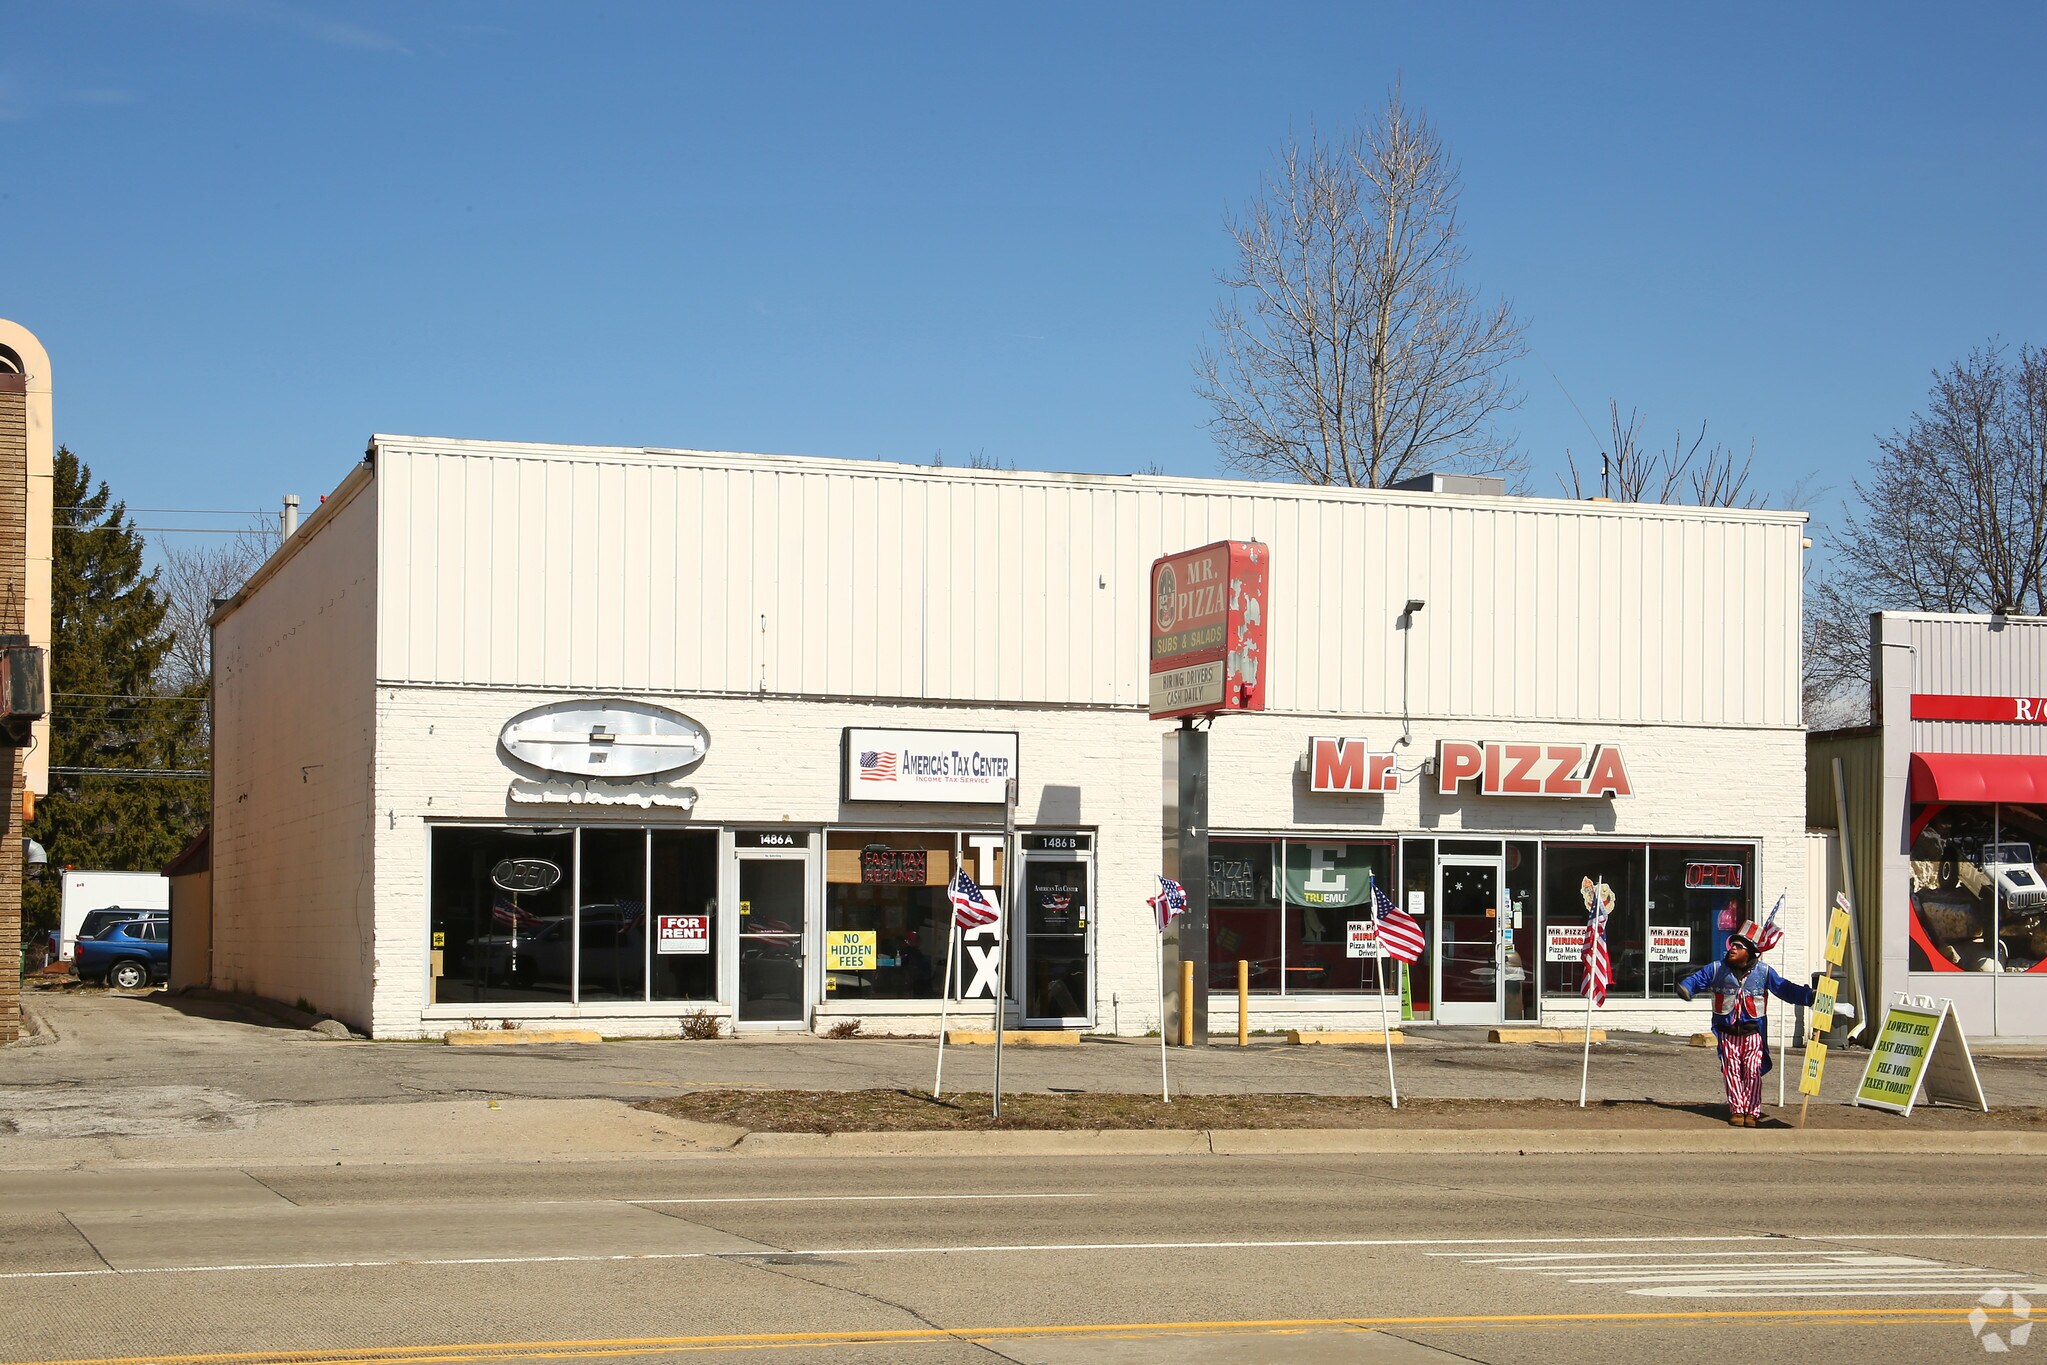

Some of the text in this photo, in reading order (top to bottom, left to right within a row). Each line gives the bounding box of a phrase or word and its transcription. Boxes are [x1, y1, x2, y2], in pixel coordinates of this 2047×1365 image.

[1187, 558, 1218, 585] MR.
[1177, 583, 1225, 622] PIZZA
[1157, 627, 1222, 654] SUBS & SALADS
[1162, 667, 1213, 690] HIRING DRIVERS
[1166, 686, 1204, 706] CASH DAILY
[1313, 738, 1632, 796] Mr. PIZZA
[760, 834, 794, 845] 1486 A
[1043, 838, 1077, 848] 1486 B
[864, 851, 925, 866] FAST TAX
[494, 859, 557, 890] OPEN
[1212, 861, 1252, 878] PIZZA
[1304, 843, 1346, 891] E
[864, 868, 925, 882] REFUNDS
[1688, 864, 1741, 887] OPEN
[1223, 880, 1252, 898] LATE
[667, 918, 700, 928] FOR
[662, 929, 705, 939] RENT
[843, 933, 860, 944] NO
[1667, 929, 1689, 937] PIZZA
[1832, 927, 1842, 947] NO
[1653, 937, 1686, 946] HIRING
[831, 945, 872, 955] HIDDEN
[1548, 946, 1564, 954] Pizza
[839, 956, 864, 967] FEES
[1887, 1020, 1913, 1034] LOWEST
[1878, 1041, 1895, 1053] FAST
[1876, 1062, 1911, 1077] FILE YOUR
[1864, 1077, 1912, 1095] TAXES TODAY!!
